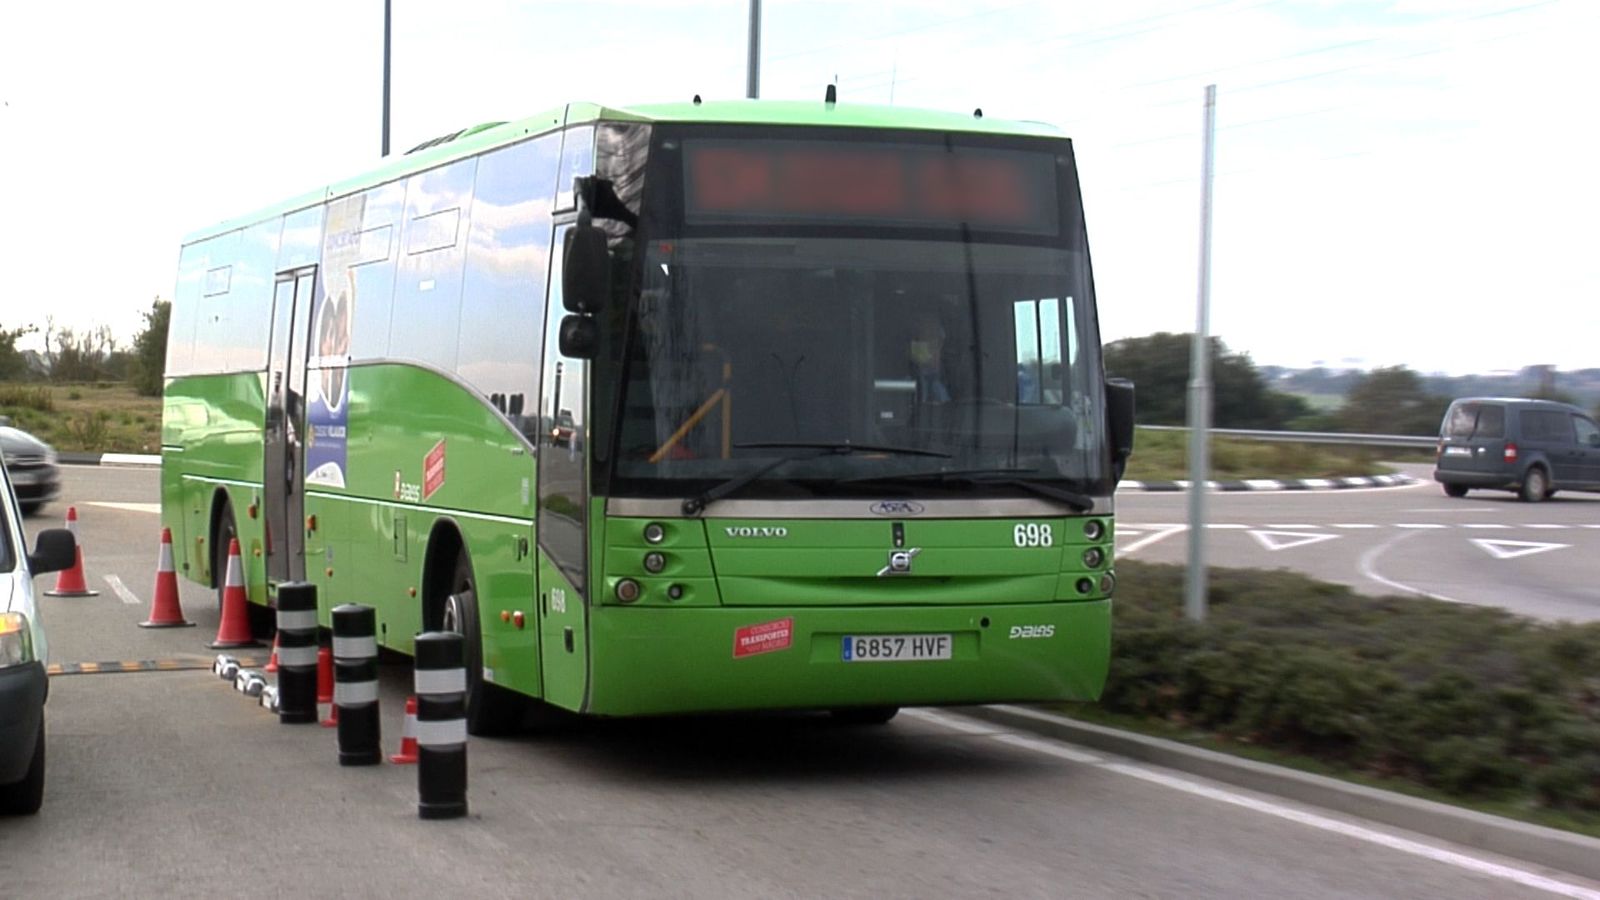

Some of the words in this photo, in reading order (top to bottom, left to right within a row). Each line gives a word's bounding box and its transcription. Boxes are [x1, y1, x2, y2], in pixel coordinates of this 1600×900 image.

[725, 527, 788, 538] VOLVO
[1014, 523, 1053, 548] 698
[551, 587, 566, 613] 698
[855, 637, 905, 658] 6857
[912, 636, 947, 658] HVF
